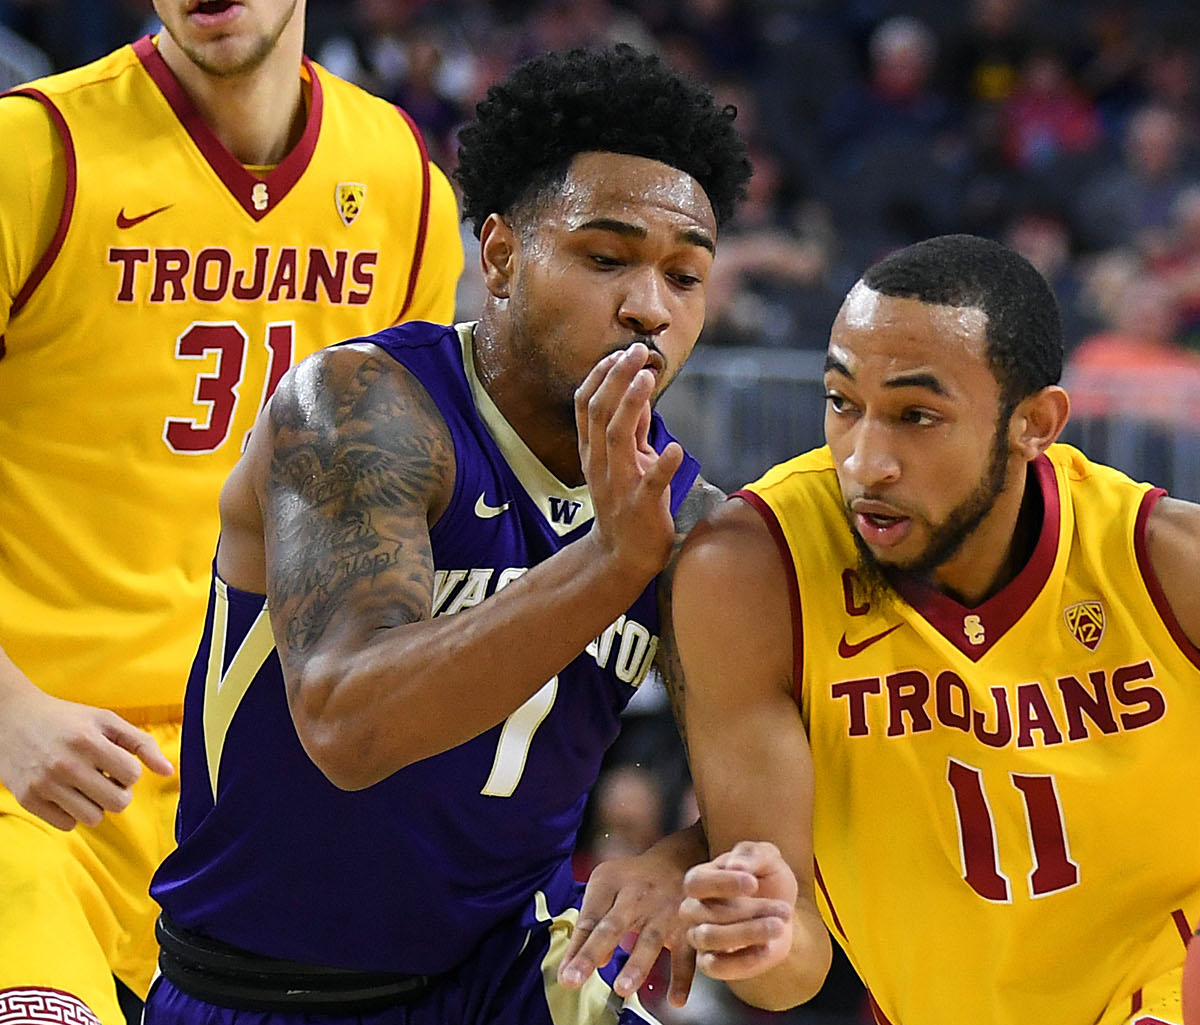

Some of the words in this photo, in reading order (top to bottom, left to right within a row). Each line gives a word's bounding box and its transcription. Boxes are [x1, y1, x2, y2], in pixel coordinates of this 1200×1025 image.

[108, 247, 379, 306] TROJANS
[548, 495, 584, 526] W
[1066, 603, 1103, 635] PAC
[1077, 622, 1100, 643] 12
[830, 659, 1167, 749] TROJANS
[946, 755, 1081, 904] 11
